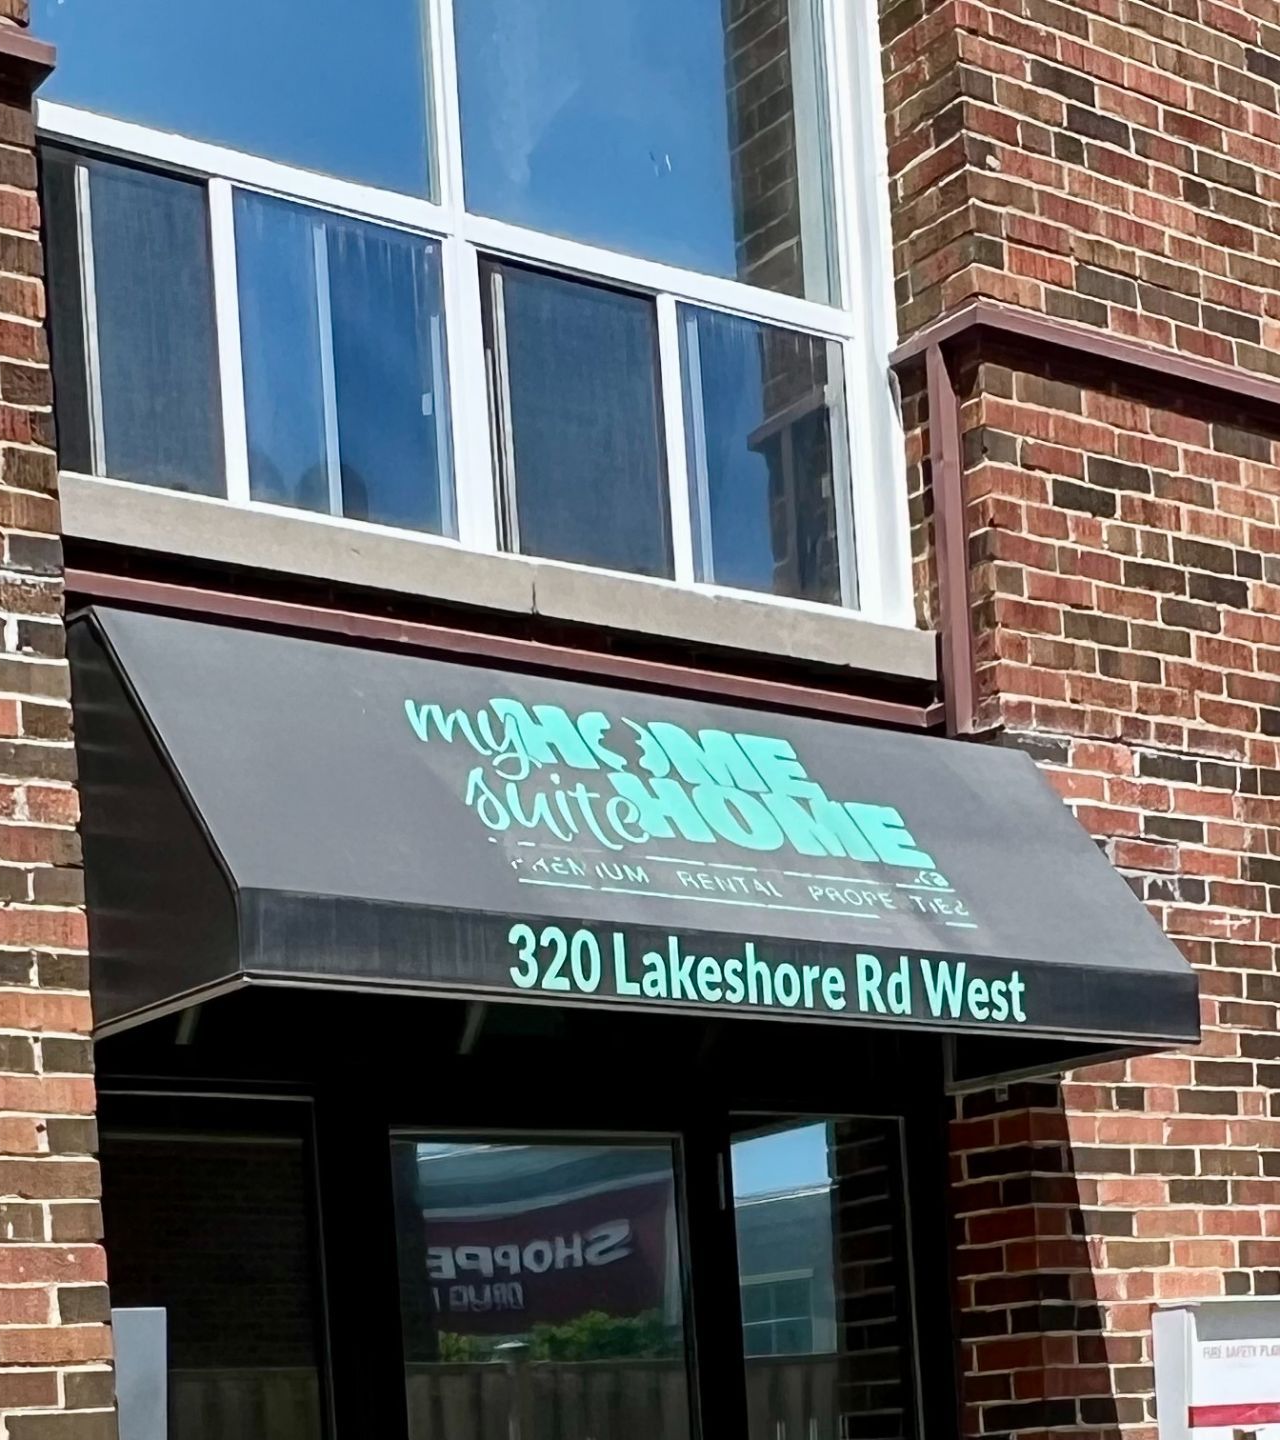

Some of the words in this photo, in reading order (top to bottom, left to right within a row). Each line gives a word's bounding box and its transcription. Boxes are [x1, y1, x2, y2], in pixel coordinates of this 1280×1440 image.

[404, 698, 543, 781] my
[464, 766, 650, 851] suite
[606, 771, 938, 870] HOME
[675, 869, 784, 898] RENTAL
[807, 884, 970, 917] PROPETIES
[507, 922, 602, 995] 320
[613, 931, 848, 1011] Lakeshore
[855, 952, 913, 1016] Rd
[920, 959, 1028, 1023] West
